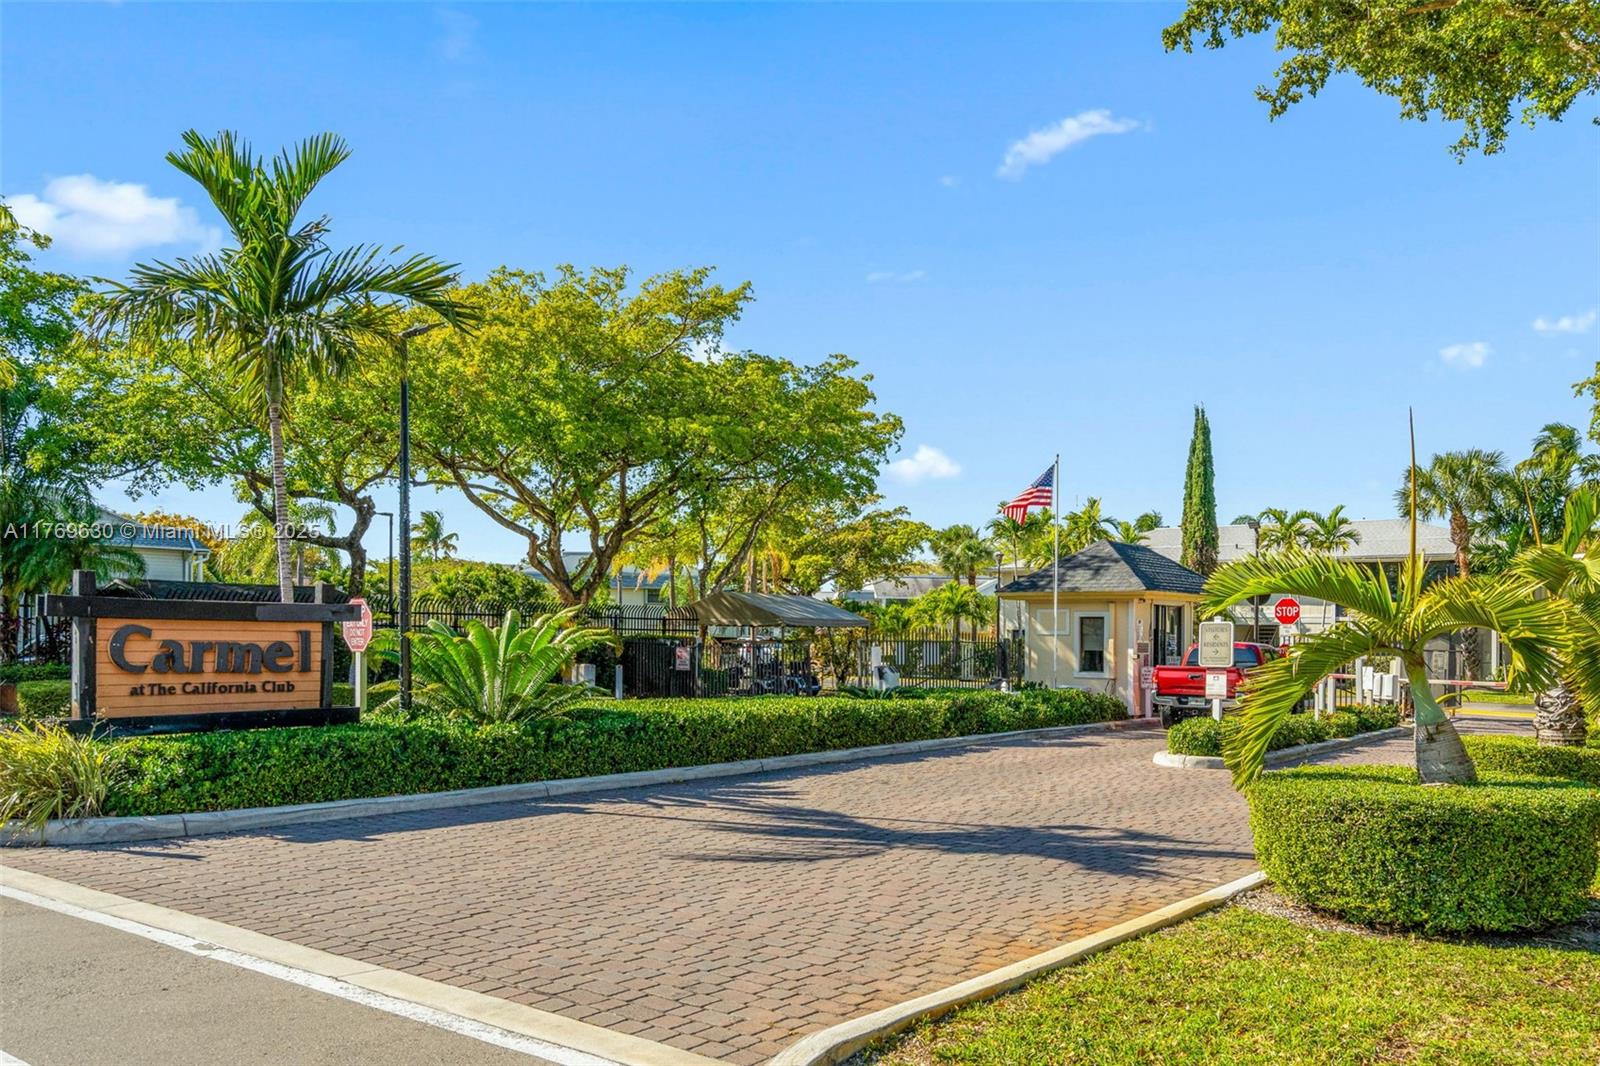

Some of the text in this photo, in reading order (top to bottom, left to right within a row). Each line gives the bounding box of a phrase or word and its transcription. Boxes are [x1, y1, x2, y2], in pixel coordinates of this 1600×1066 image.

[1276, 606, 1299, 617] STOP
[109, 623, 312, 674] Carmel
[130, 680, 295, 696] at The California Club
